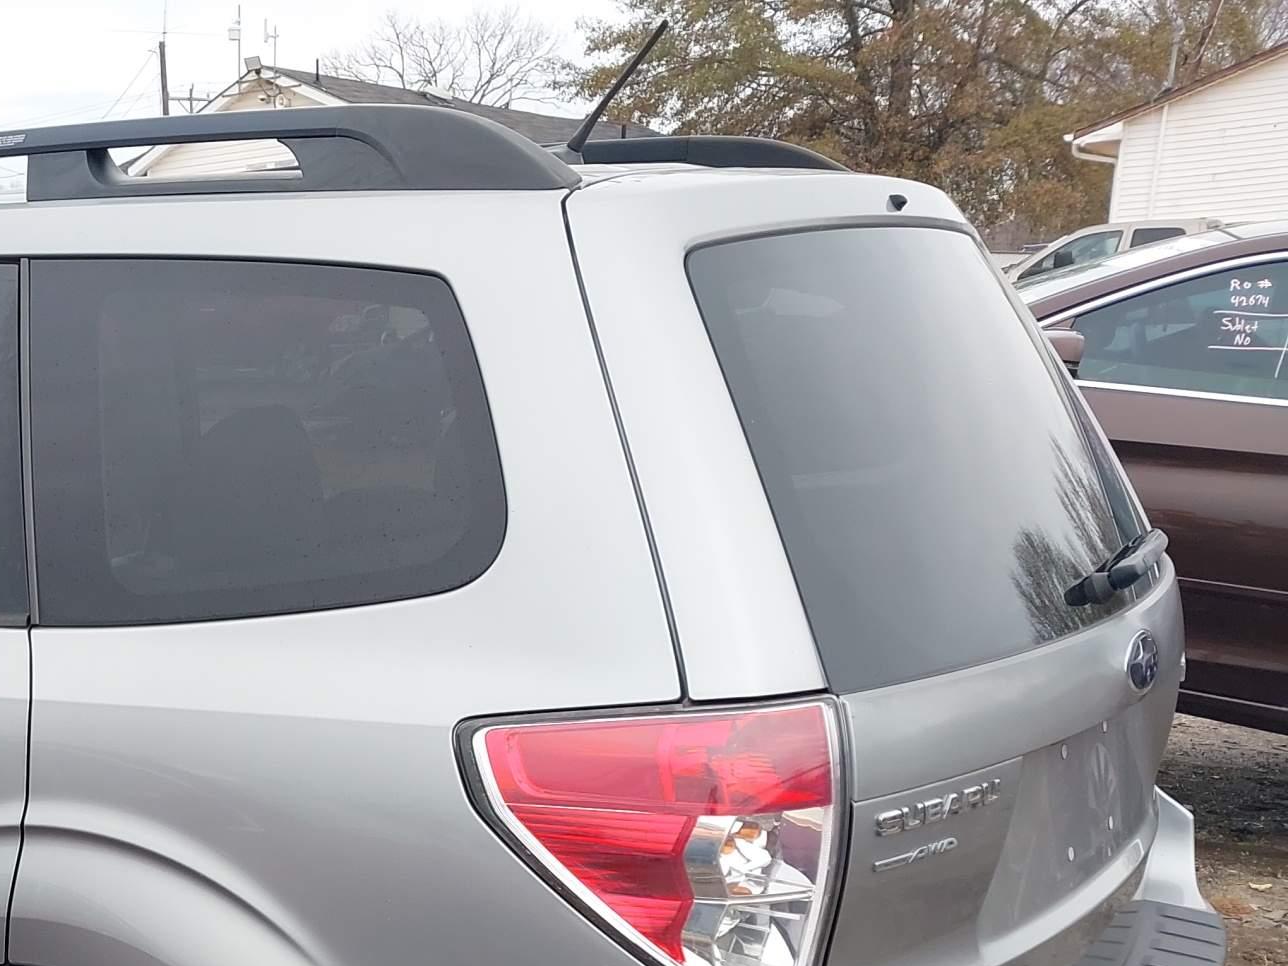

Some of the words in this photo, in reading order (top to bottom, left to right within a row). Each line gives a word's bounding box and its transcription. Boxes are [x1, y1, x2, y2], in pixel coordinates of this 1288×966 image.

[1220, 317, 1259, 333] Sublet
[1233, 333, 1251, 346] No
[875, 779, 1001, 836] SUBARU
[908, 837, 958, 864] AWD
